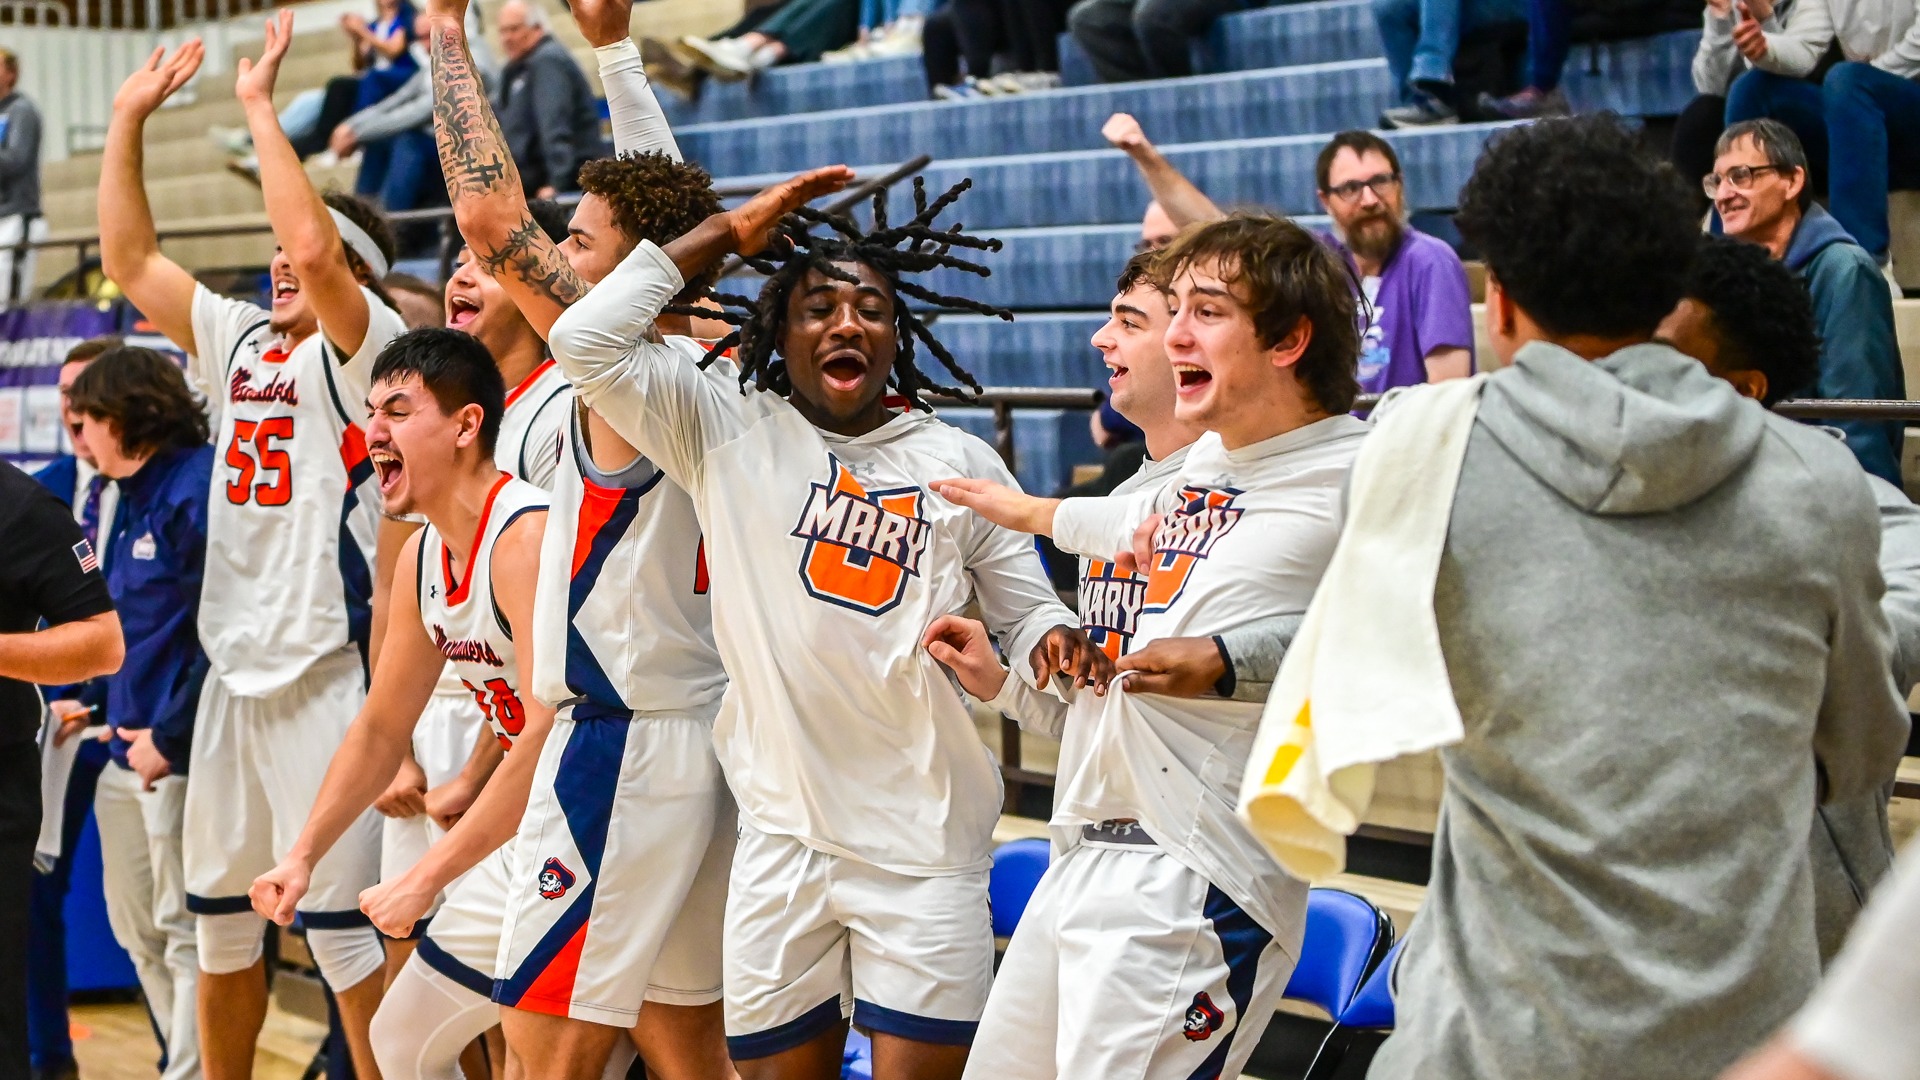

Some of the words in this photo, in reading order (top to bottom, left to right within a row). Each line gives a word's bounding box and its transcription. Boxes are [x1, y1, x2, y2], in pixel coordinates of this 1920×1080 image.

[452, 79, 486, 144] FIRST
[225, 416, 294, 506] 55
[792, 484, 931, 577] MARY
